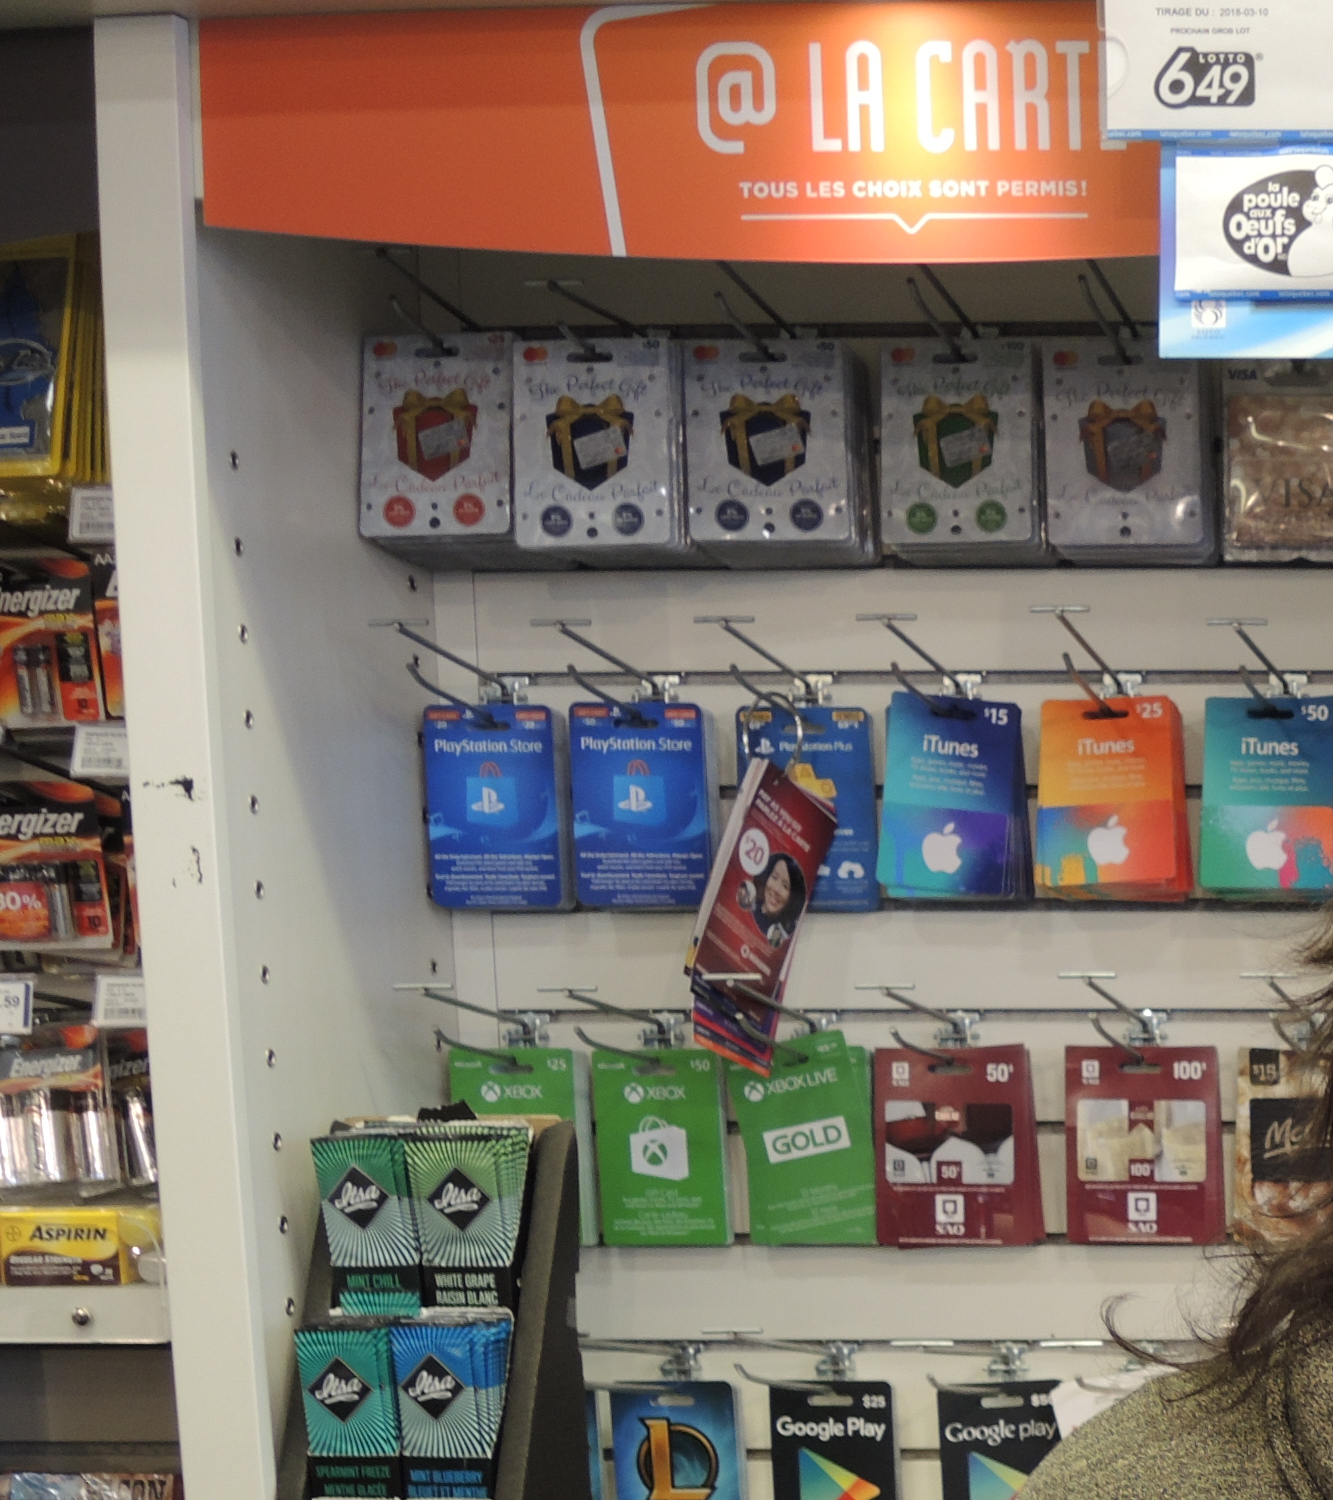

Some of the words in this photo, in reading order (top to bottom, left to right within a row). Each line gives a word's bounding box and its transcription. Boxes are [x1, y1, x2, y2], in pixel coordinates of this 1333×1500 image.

[1156, 8, 1193, 17] TIRAGE
[1195, 8, 1210, 17] DU
[1236, 27, 1250, 35] LOT
[1198, 53, 1246, 64] LOTTO
[808, 40, 883, 153] LA
[739, 181, 800, 199] TOUS
[806, 181, 846, 198] LES
[852, 180, 922, 198] CHOIX
[928, 180, 990, 198] SONT
[996, 180, 1088, 198] PERMIS!
[1243, 187, 1301, 212] poule
[984, 707, 1009, 726] $15
[1136, 702, 1164, 720] $25
[1300, 704, 1330, 723] $50
[434, 738, 511, 755] PlayStation
[513, 739, 543, 755] Store
[580, 736, 656, 753] PlayStation
[660, 736, 692, 752] Store
[922, 733, 979, 758] iTunes
[1076, 735, 1135, 756] iTunes
[1240, 736, 1299, 757] iTunes
[765, 1074, 806, 1096] XBOX
[806, 1067, 839, 1089] LIVE
[502, 1084, 543, 1100] XBOX
[645, 1085, 686, 1101] XBOX
[771, 1125, 842, 1157] GOLD
[29, 1225, 109, 1242] ASPIRIN
[434, 1273, 463, 1288] WHITE
[465, 1273, 496, 1288] GRAPE
[776, 1415, 844, 1441] Google
[846, 1418, 886, 1442] Play
[945, 1420, 1017, 1447] Google
[1018, 1421, 1057, 1444] play
